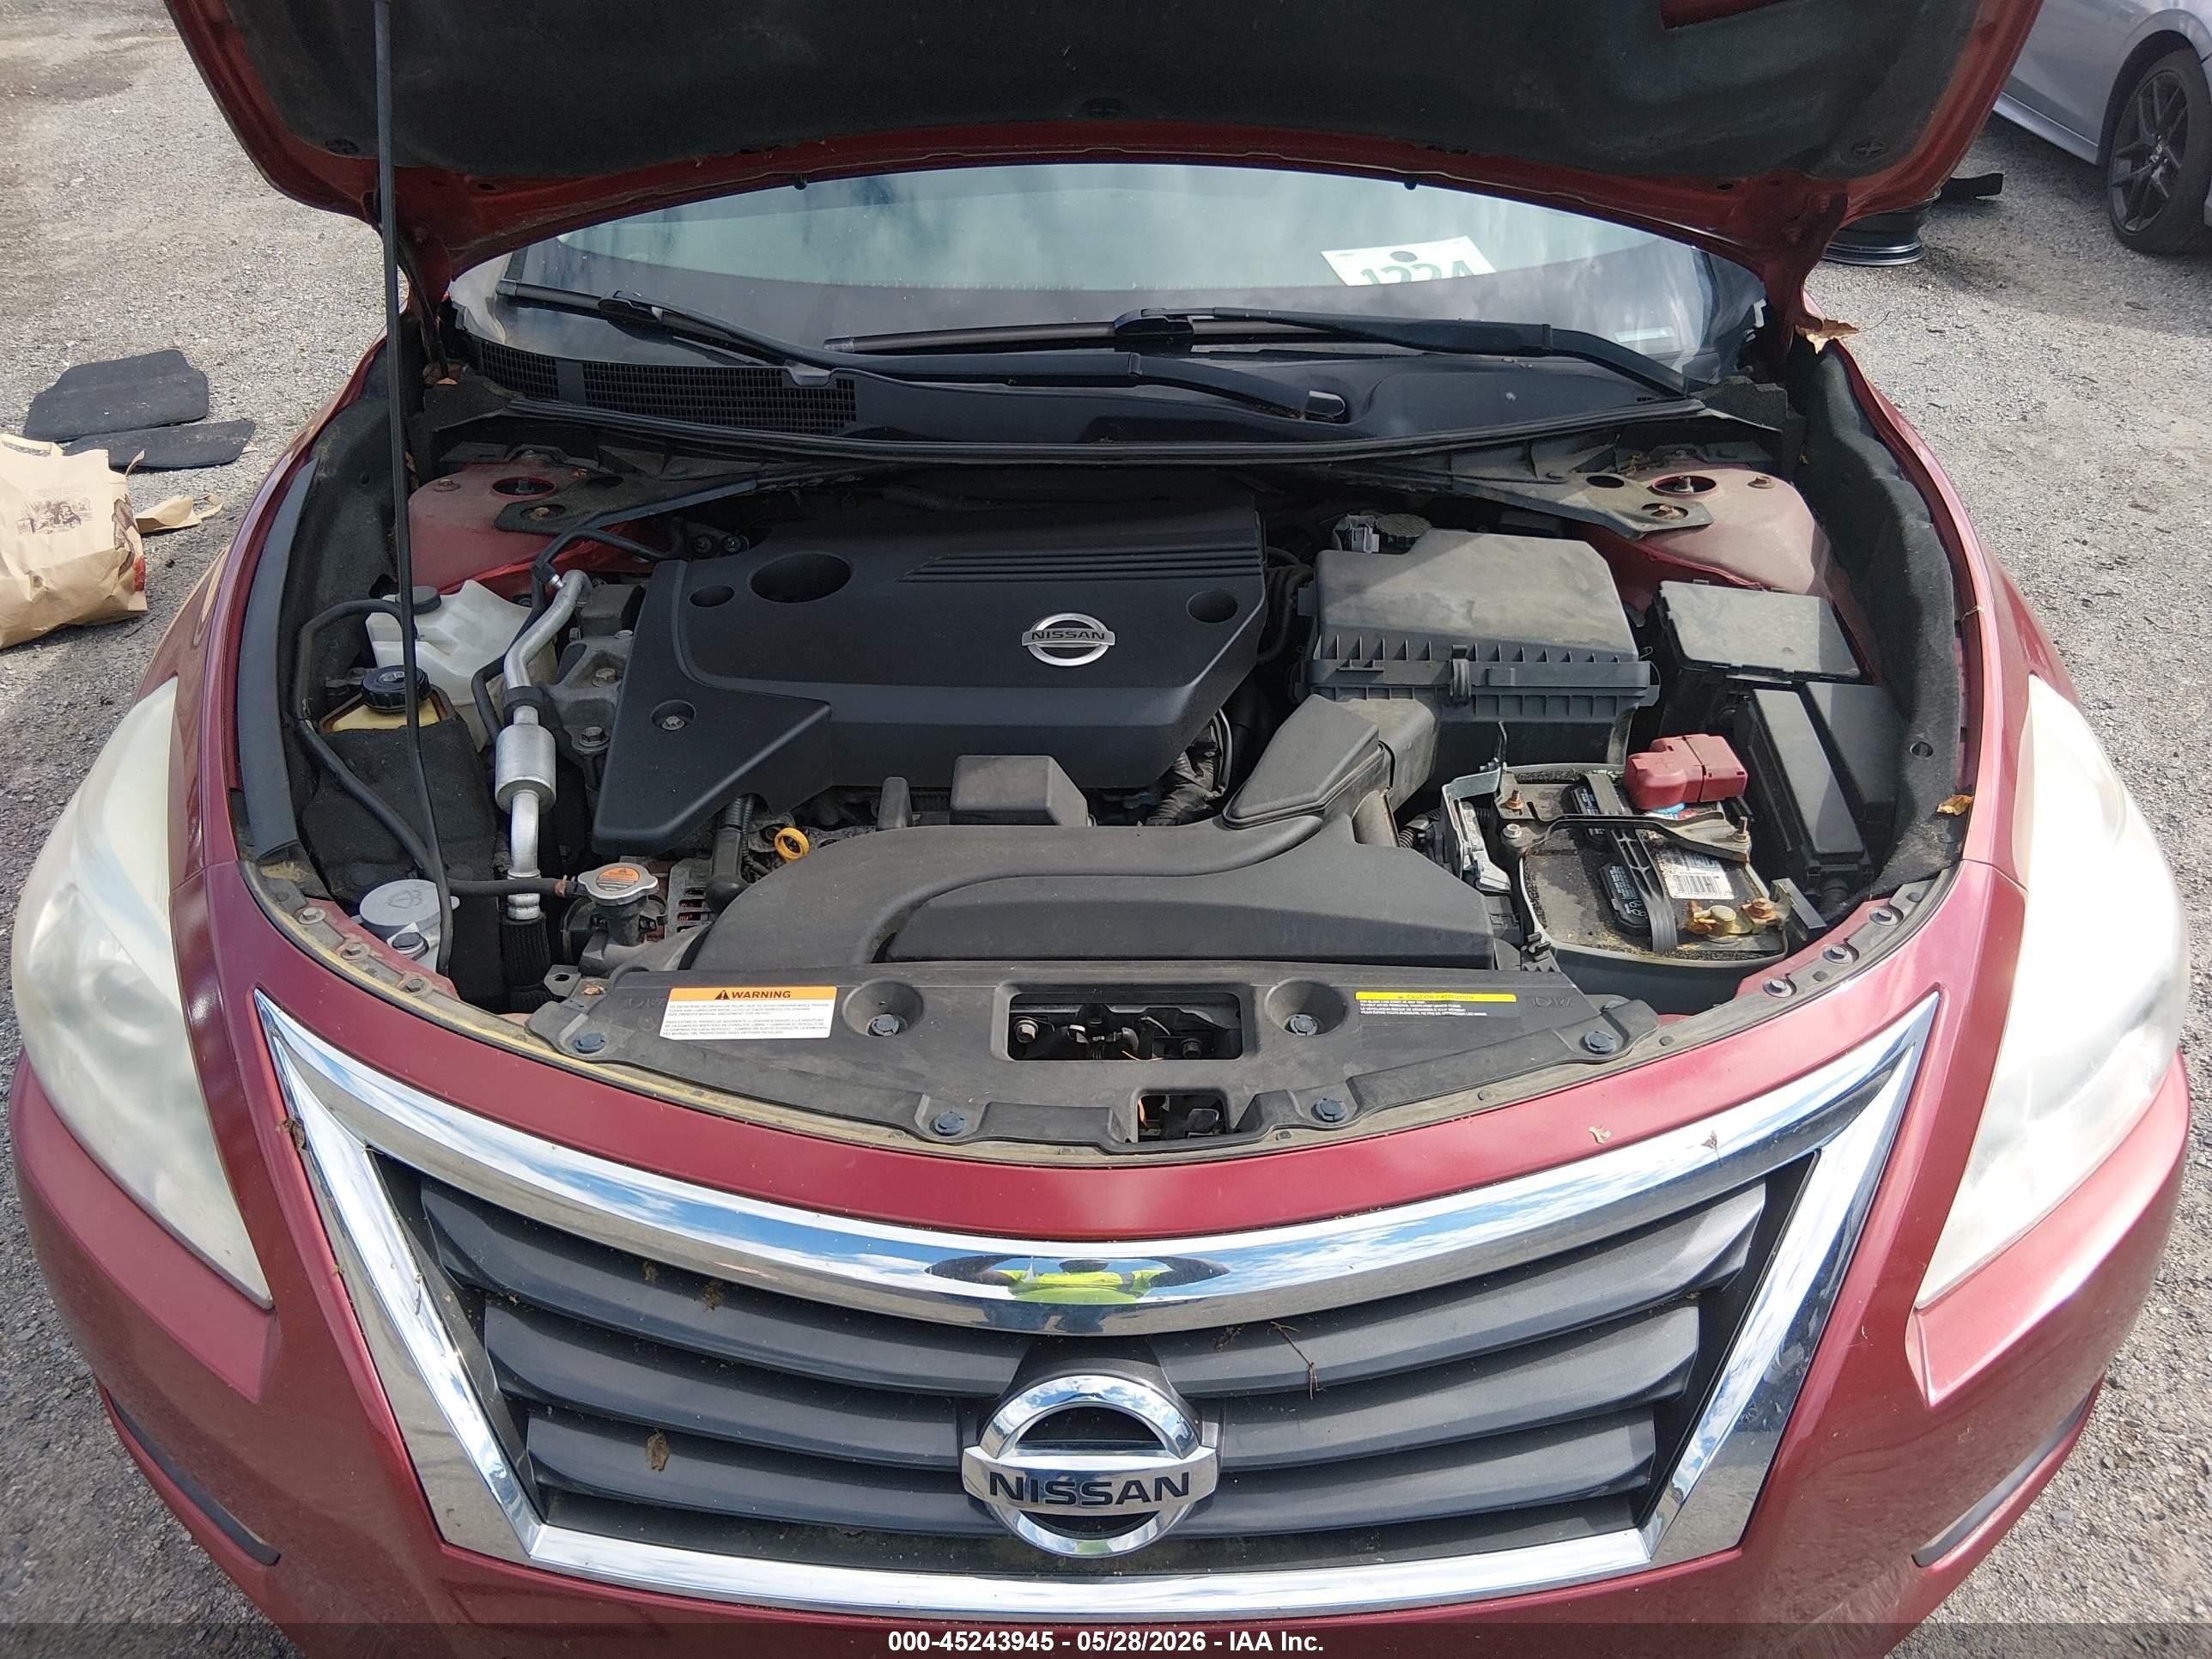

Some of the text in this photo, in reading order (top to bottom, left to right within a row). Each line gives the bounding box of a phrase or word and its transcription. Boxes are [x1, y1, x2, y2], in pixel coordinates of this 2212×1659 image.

[1031, 631, 1105, 640] NISSAN
[732, 990, 792, 999] WARNING
[989, 1472, 1189, 1505] NISSAN
